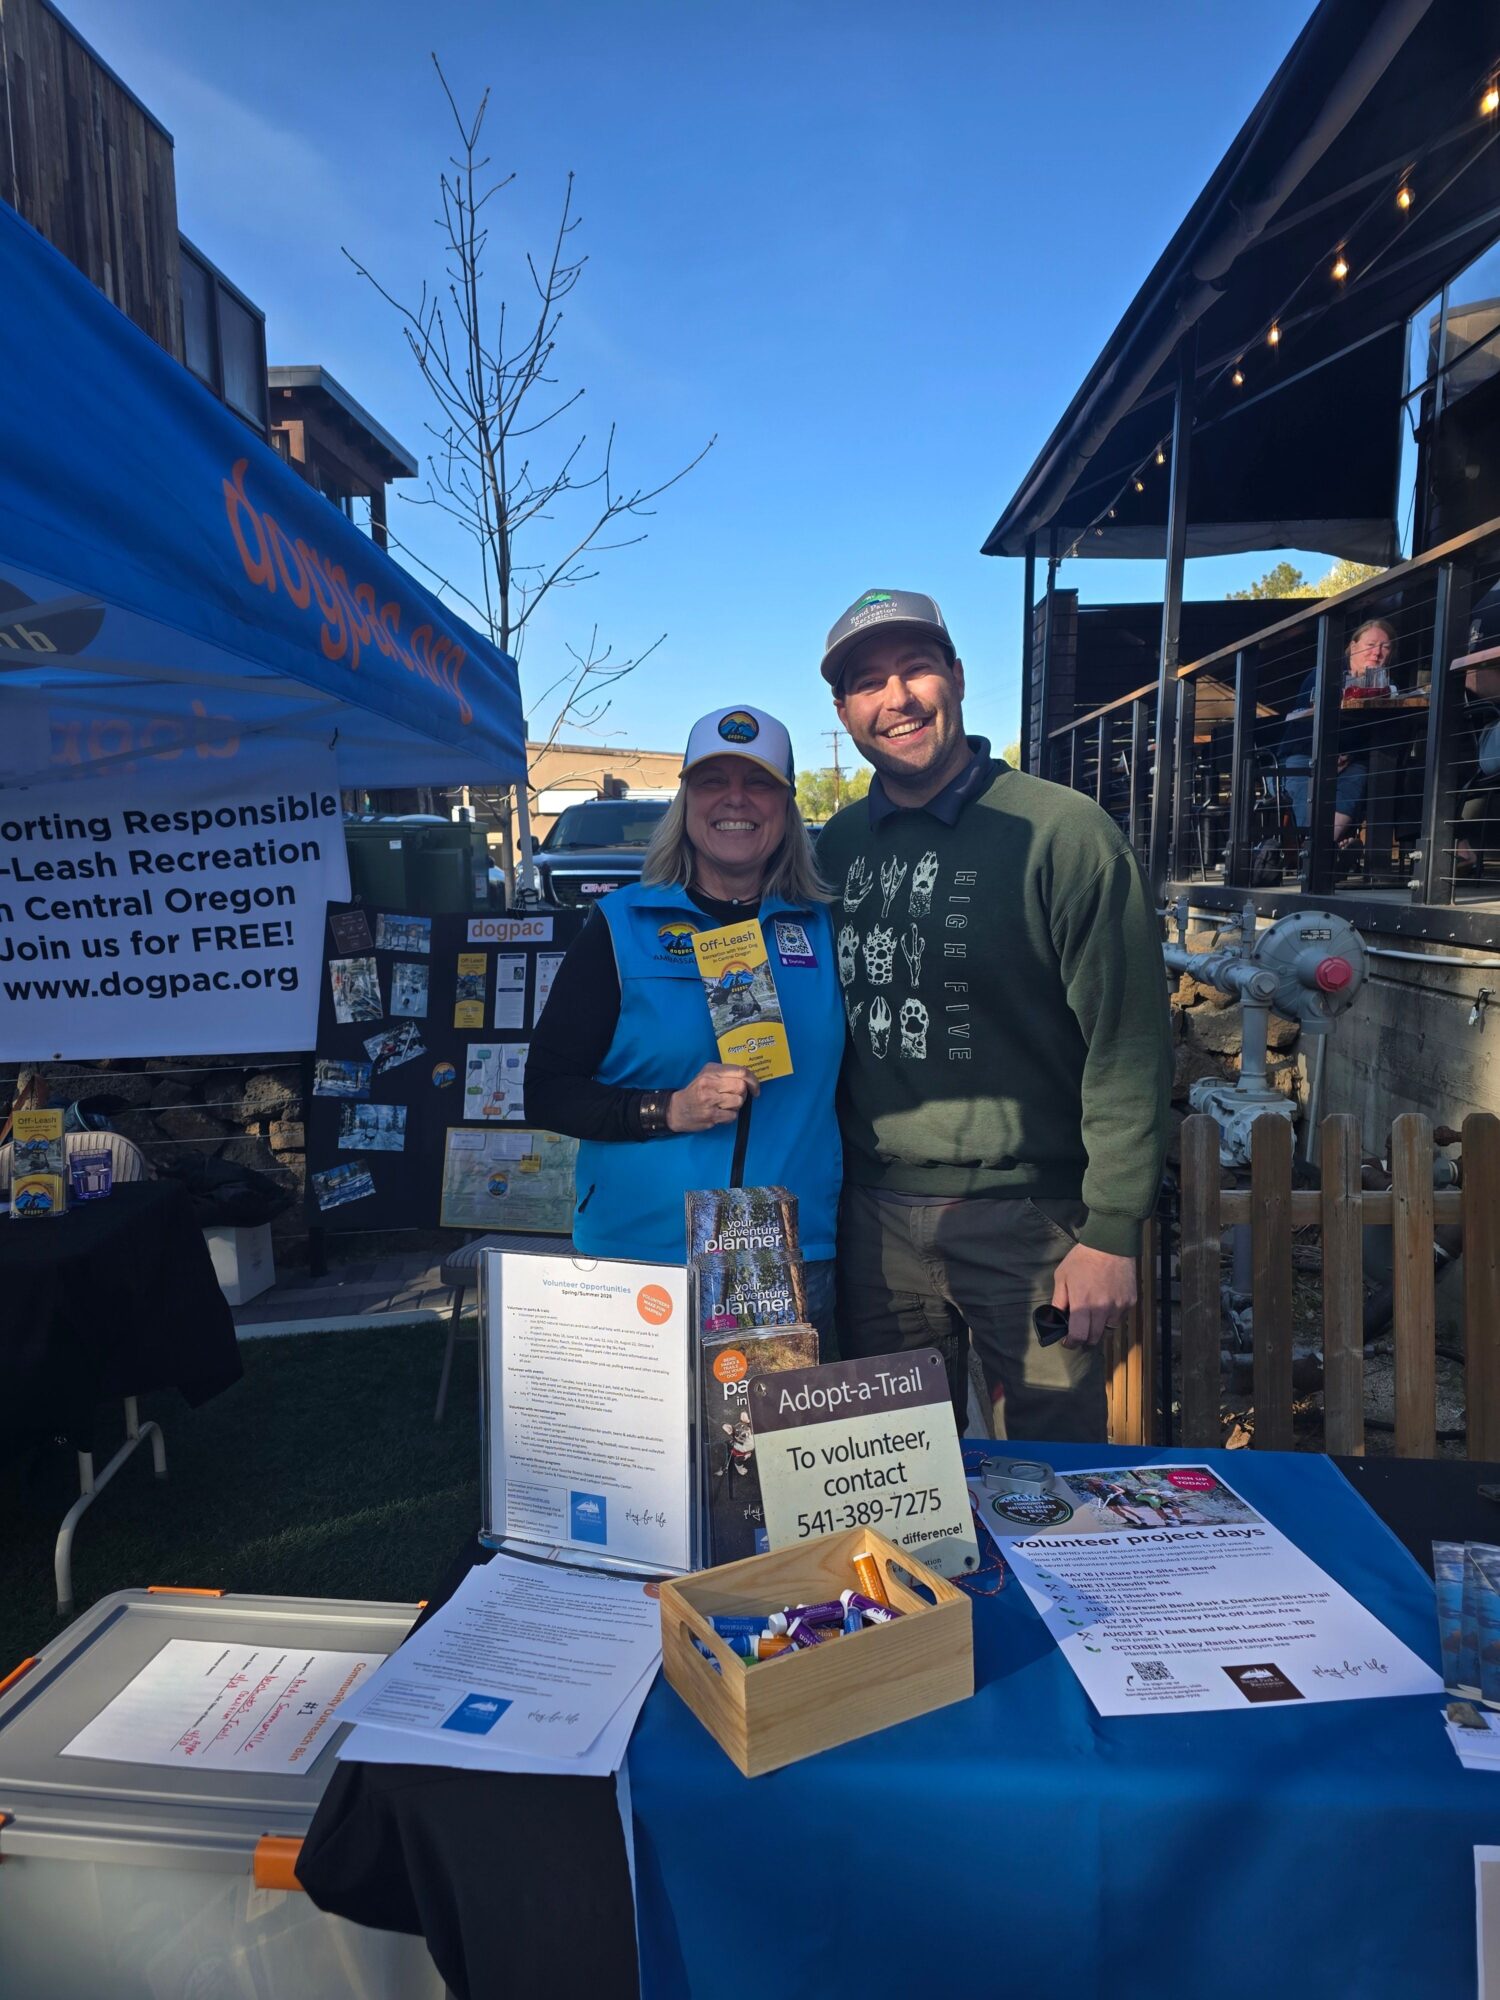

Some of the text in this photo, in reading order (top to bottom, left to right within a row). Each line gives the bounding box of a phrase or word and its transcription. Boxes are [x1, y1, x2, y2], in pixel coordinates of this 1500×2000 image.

[222, 458, 473, 726] dogpac.org
[870, 603, 890, 612] Park
[123, 792, 337, 835] Responsible
[0, 839, 321, 882] -Leash Recreation
[581, 884, 618, 892] GMC
[25, 890, 153, 921] Central
[165, 885, 296, 914] Oregon
[944, 871, 977, 958] HIGH
[472, 920, 544, 941] dogpac
[0, 921, 294, 962] Join us for FREE!
[700, 931, 756, 953] Off-Leash
[653, 954, 697, 965] AMBASSA
[3, 966, 299, 1001] www.dogpac.org
[944, 982, 972, 1060] FIVE
[722, 1227, 780, 1238] adventure
[727, 1219, 753, 1230] your
[705, 1233, 783, 1253] planner
[730, 1289, 789, 1301] adventure
[735, 1282, 762, 1294] your
[712, 1297, 793, 1320] planner
[778, 1366, 923, 1415] Adopt-a-Trail
[787, 1430, 931, 1471] To volunteer,
[824, 1462, 908, 1496] contact
[625, 1509, 640, 1526] play
[640, 1509, 654, 1526] for
[655, 1512, 666, 1528] life
[797, 1488, 942, 1538] 541-389-7275
[902, 1523, 963, 1545] difference!
[1012, 1528, 1265, 1548] volunteer project days
[1229, 1596, 1281, 1604] Deschutes
[1228, 1609, 1276, 1617] Off-Leash
[1242, 1622, 1286, 1630] Location
[1275, 1633, 1316, 1641] Reserve
[1312, 1658, 1388, 1679] play for life
[328, 1662, 366, 1708] Community
[297, 1701, 319, 1716] #1
[301, 1708, 334, 1746] Outreach
[288, 1747, 307, 1761] Bin
